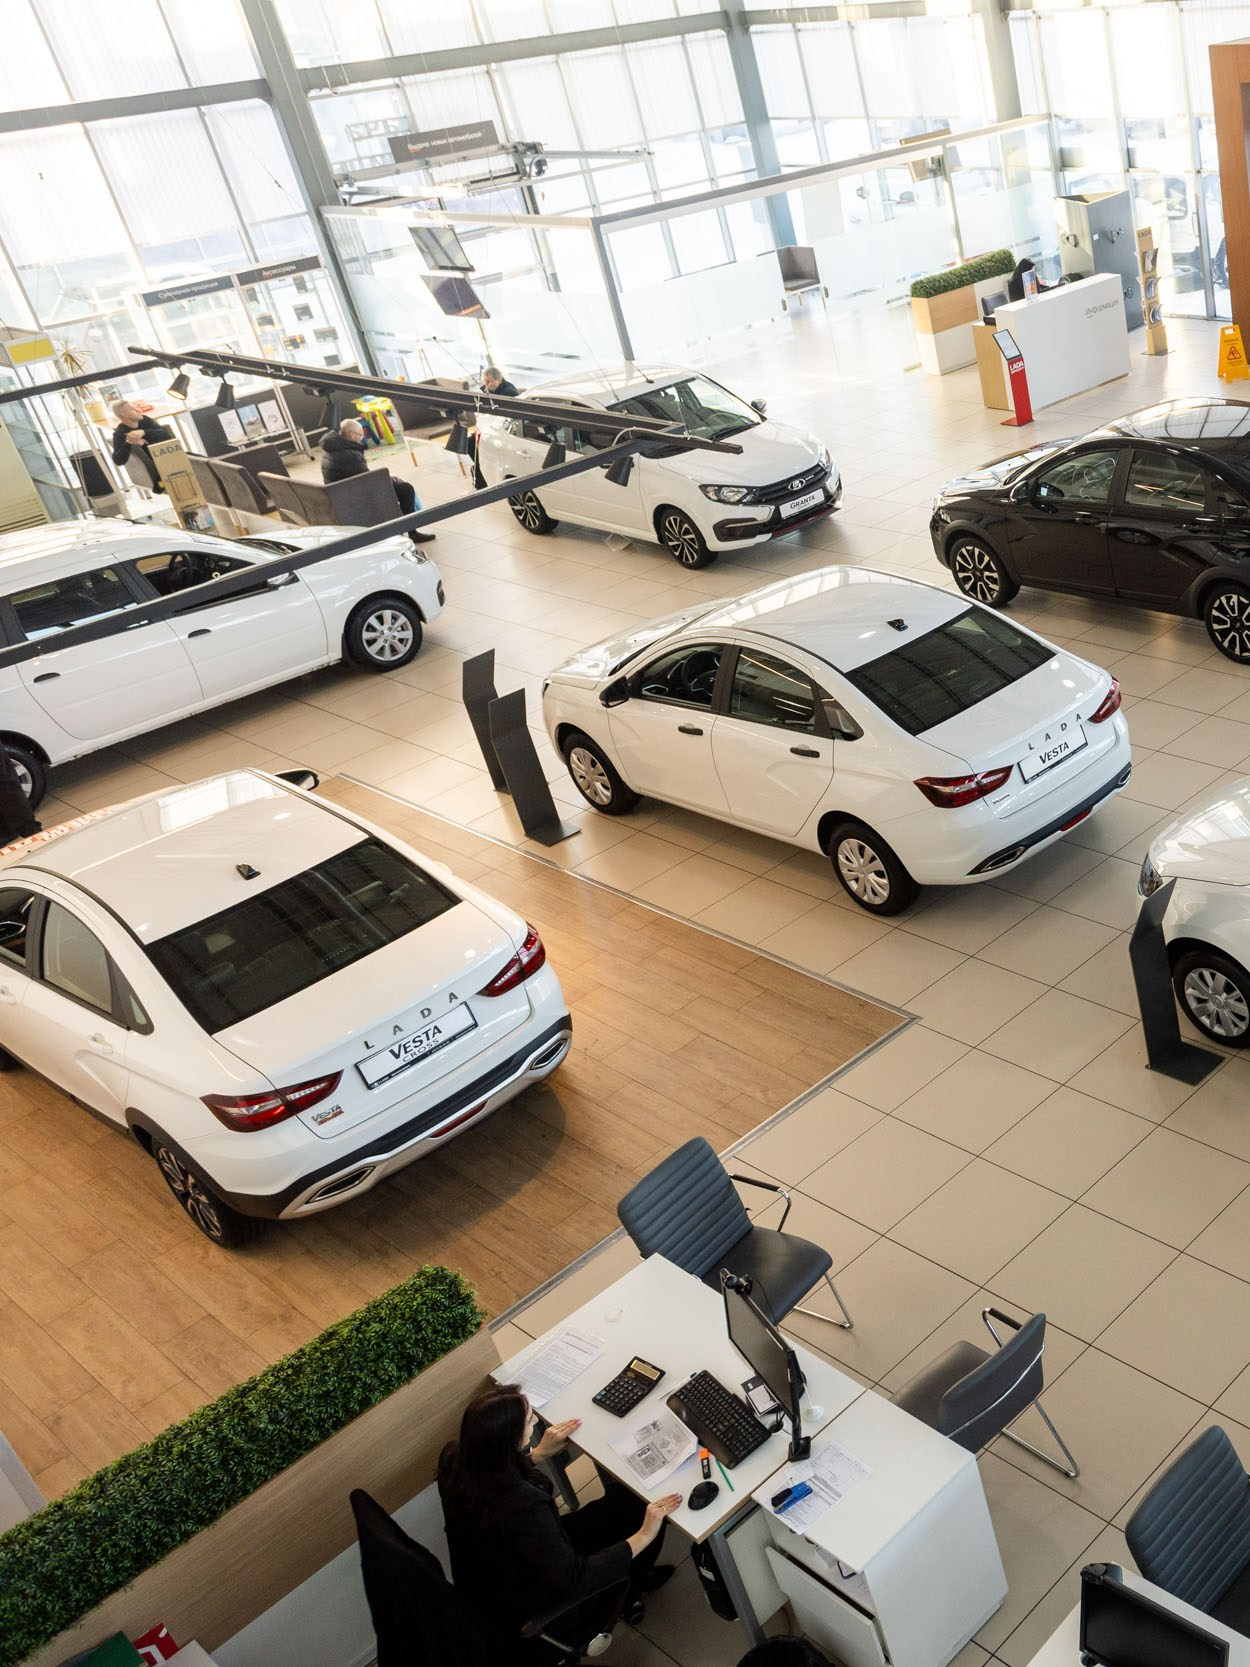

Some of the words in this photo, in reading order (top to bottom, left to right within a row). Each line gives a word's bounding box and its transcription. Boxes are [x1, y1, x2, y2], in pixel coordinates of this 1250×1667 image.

[1009, 360, 1024, 371] LADA
[152, 445, 182, 457] LADA
[790, 495, 815, 509] GRANTA
[1028, 713, 1082, 751] LADA
[1039, 741, 1070, 764] VESTA
[363, 992, 459, 1050] LADA
[389, 1025, 442, 1060] VESTA
[402, 1038, 440, 1062] CROSS
